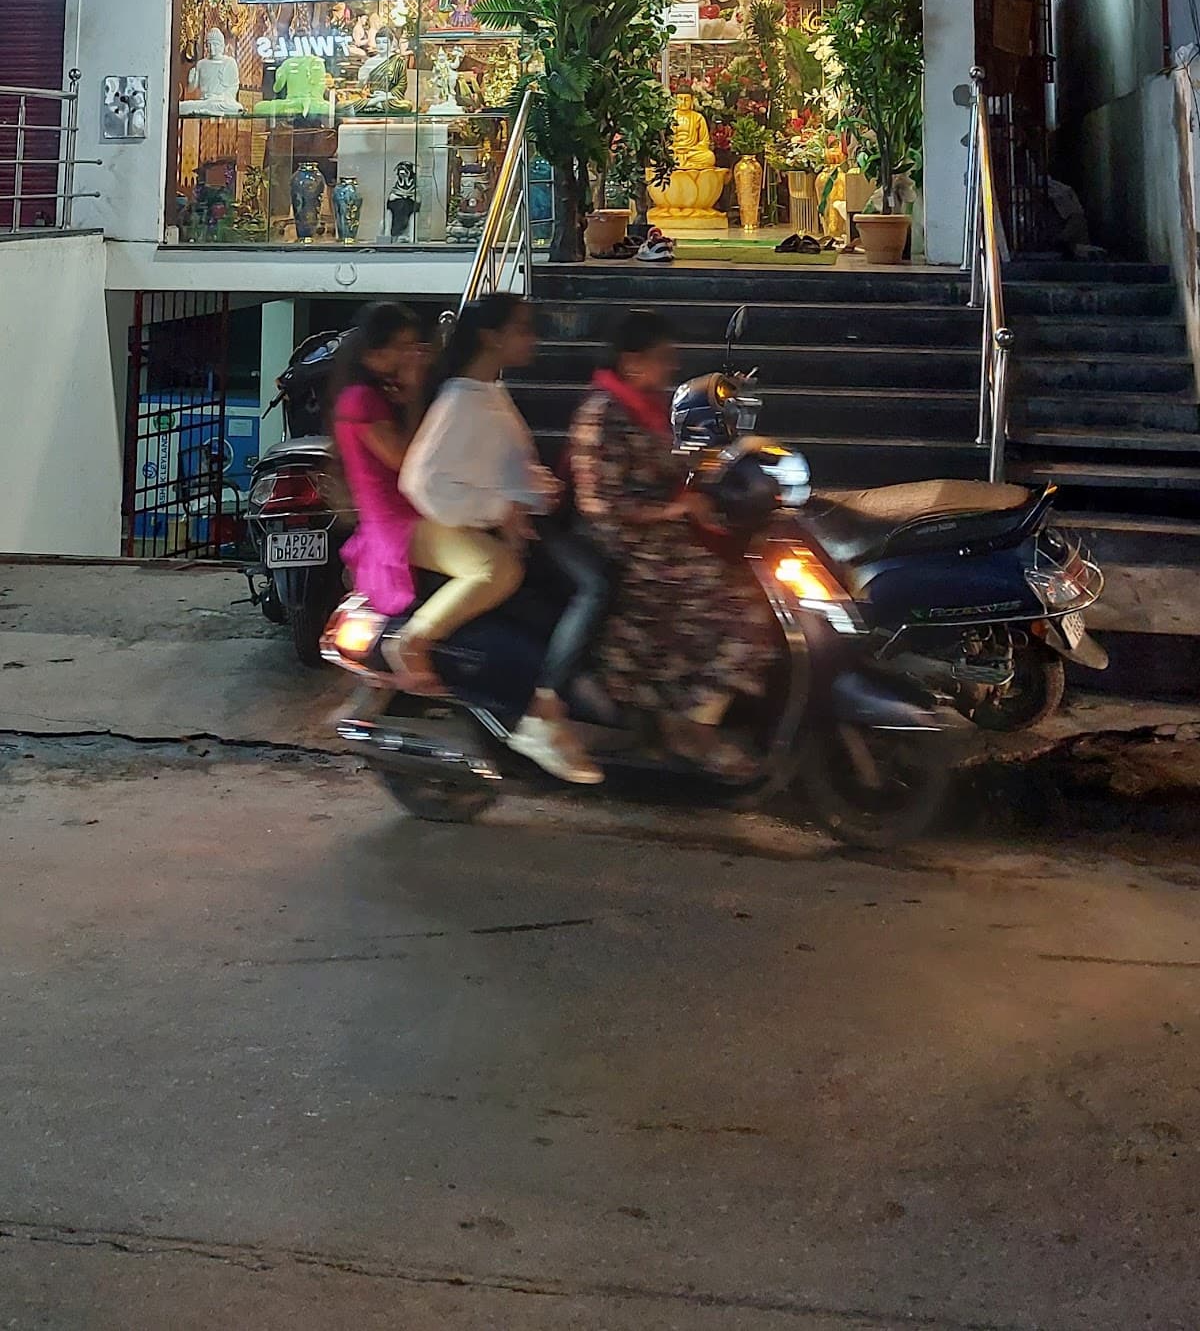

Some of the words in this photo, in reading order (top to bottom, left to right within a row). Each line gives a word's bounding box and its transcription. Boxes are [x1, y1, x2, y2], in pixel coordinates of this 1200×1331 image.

[159, 476, 168, 510] ASHK
[285, 534, 315, 547] AP07
[276, 545, 322, 560] DH2741
